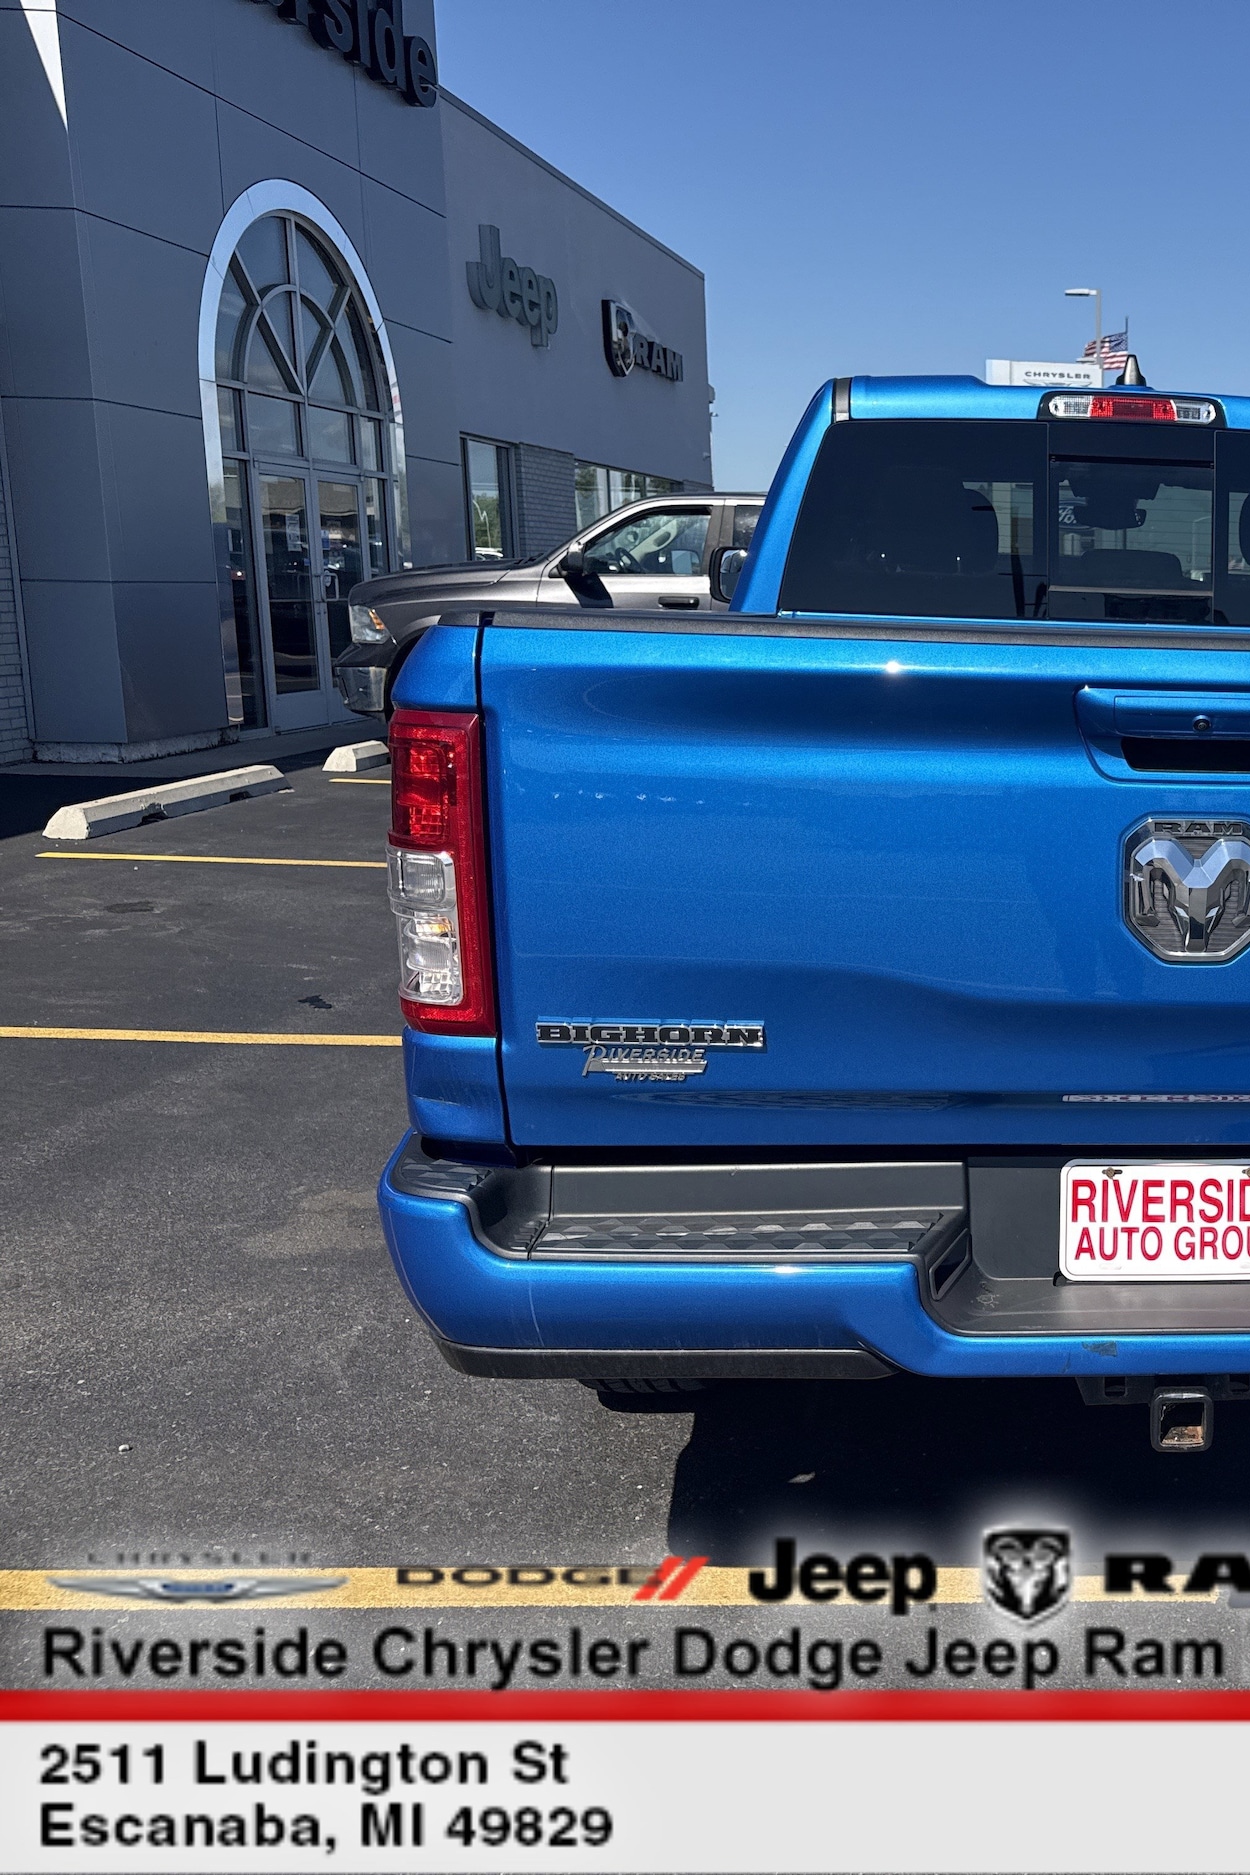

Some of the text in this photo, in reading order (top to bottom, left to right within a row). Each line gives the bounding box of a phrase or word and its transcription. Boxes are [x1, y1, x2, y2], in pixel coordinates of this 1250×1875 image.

[466, 224, 558, 347] Jeep
[633, 332, 684, 382] RAM
[1024, 370, 1091, 380] CHRYSLER
[1153, 822, 1243, 835] RAM
[535, 1021, 764, 1046] BIGHORN
[582, 1044, 705, 1076] RIVERSIDE
[1075, 1227, 1163, 1260] AUTO
